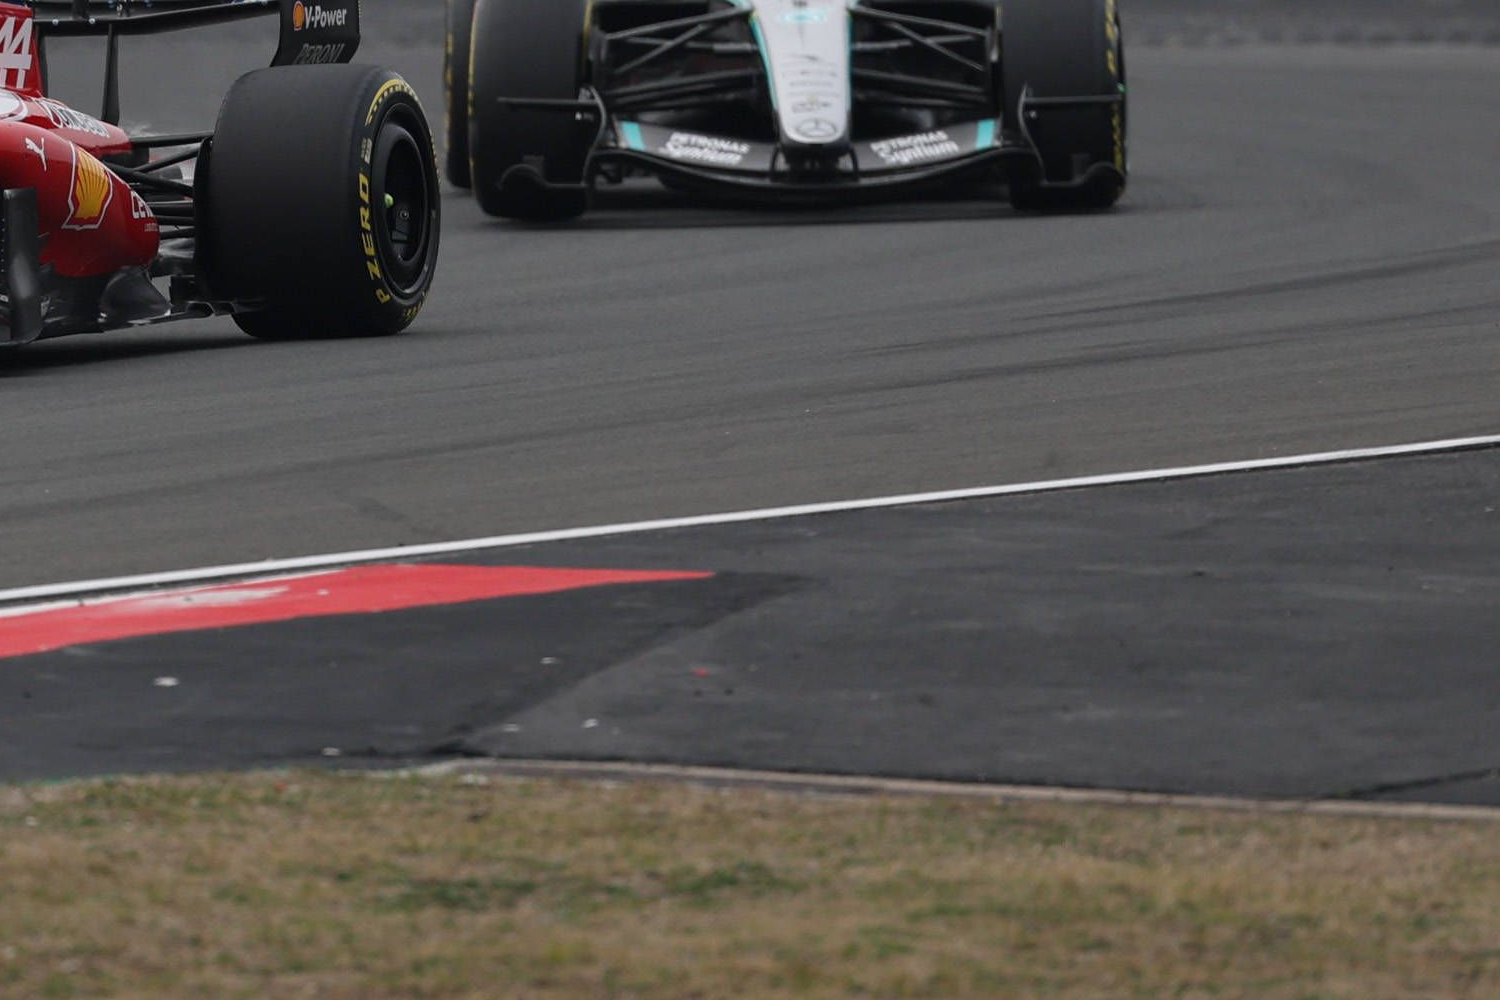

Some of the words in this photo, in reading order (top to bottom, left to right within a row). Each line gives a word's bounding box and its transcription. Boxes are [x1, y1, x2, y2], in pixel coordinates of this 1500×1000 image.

[305, 5, 348, 30] V-Power
[294, 43, 345, 64] PERONI
[357, 172, 383, 281] ZERO
